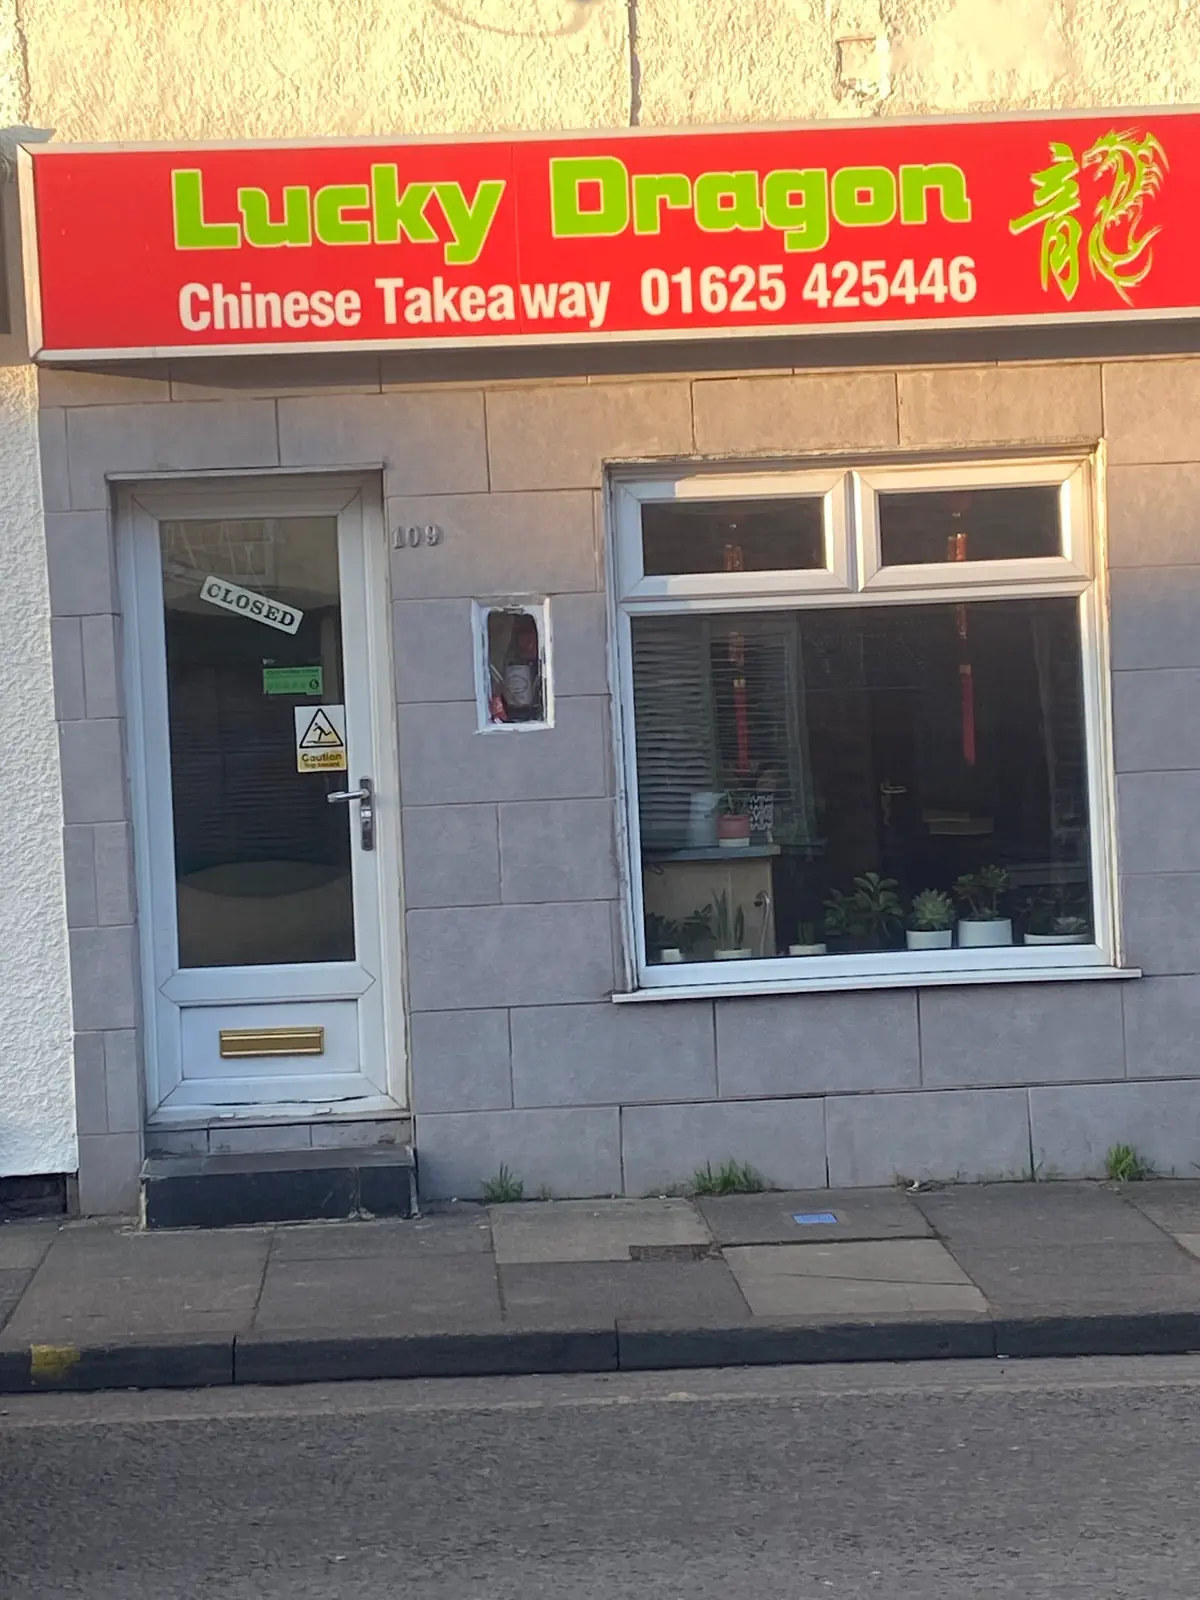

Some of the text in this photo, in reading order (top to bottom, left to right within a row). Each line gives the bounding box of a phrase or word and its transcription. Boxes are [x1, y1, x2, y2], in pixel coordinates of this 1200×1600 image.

[171, 155, 972, 265] Lucky Dragon
[178, 256, 977, 332] Chinese Takeaway 01625 425446
[391, 525, 440, 549] 109
[206, 583, 296, 627] CLOSED
[301, 752, 342, 762] Caution
